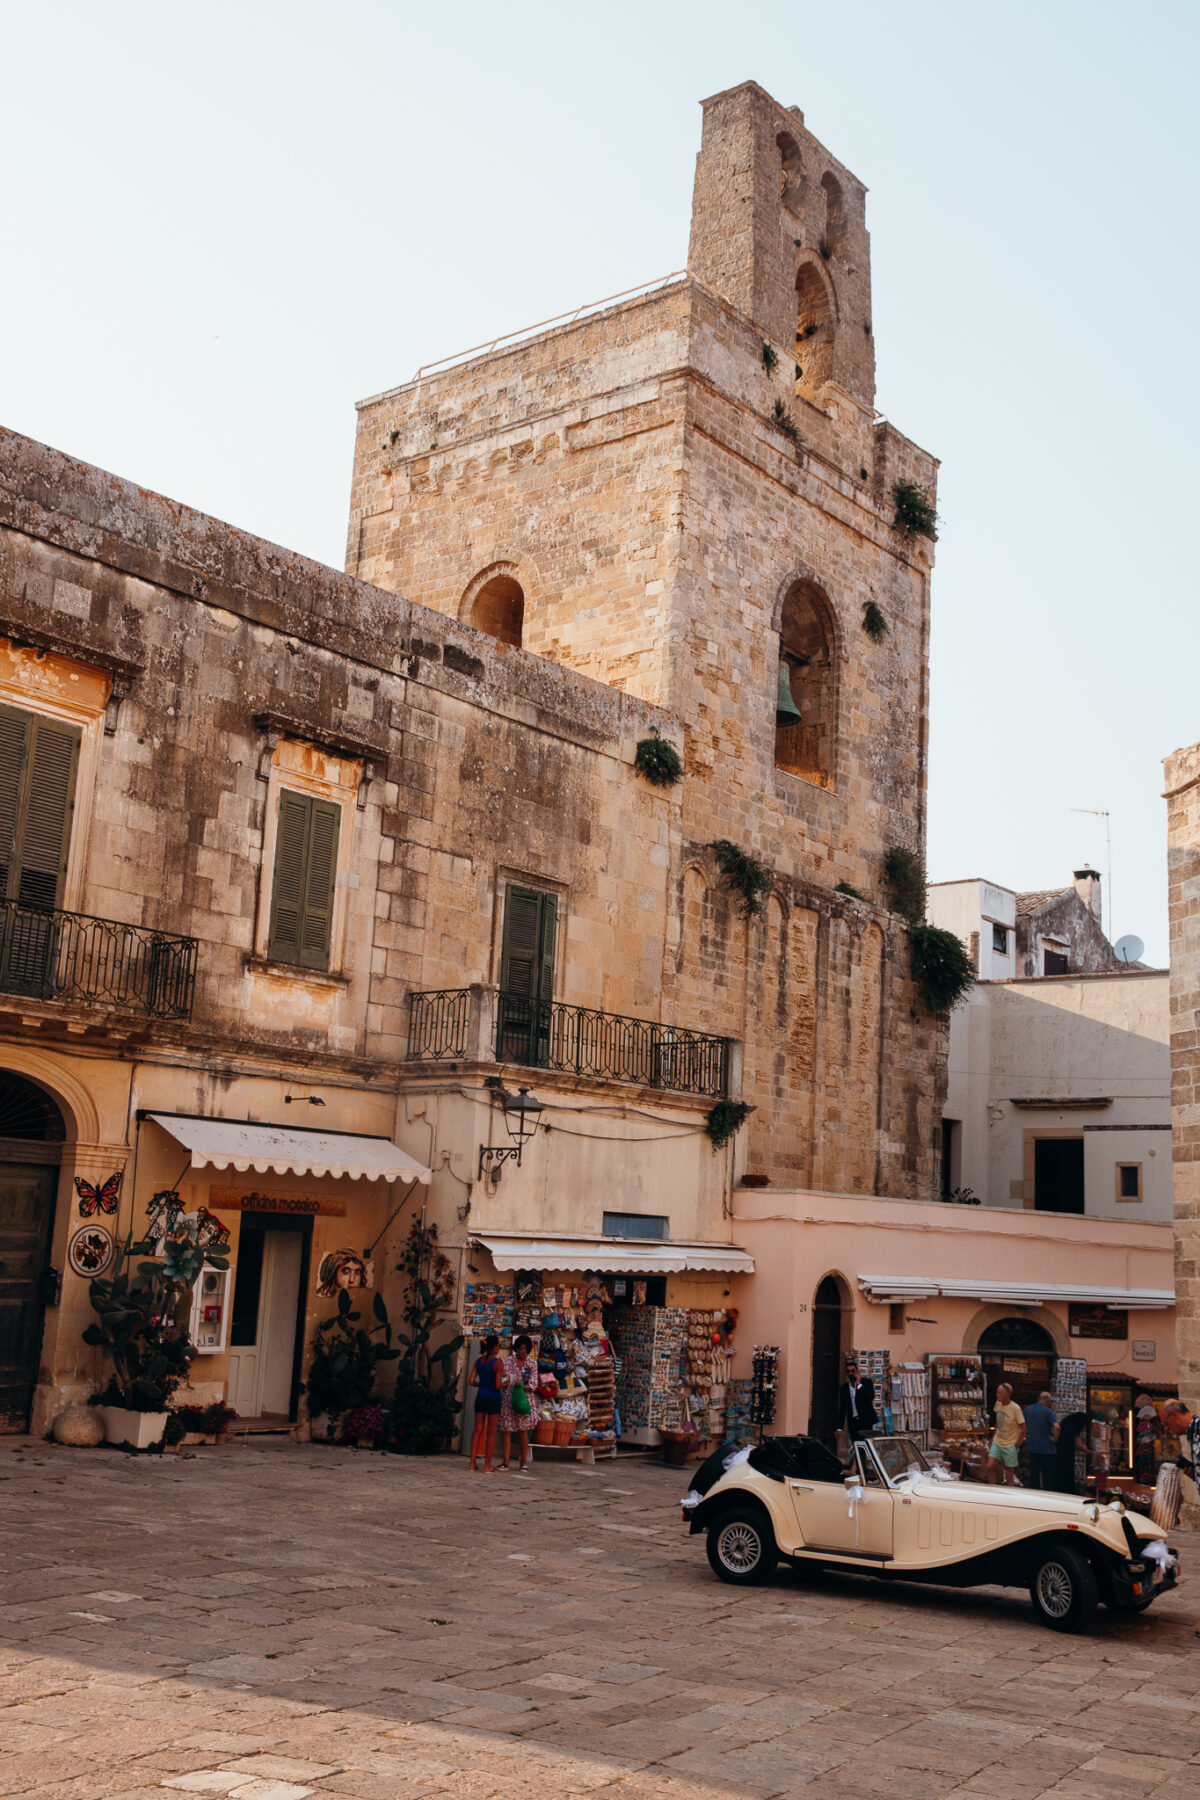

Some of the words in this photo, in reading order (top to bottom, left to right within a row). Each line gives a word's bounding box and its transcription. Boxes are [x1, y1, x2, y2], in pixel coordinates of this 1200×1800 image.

[240, 1192, 277, 1210] officina
[279, 1197, 321, 1212] mosaico
[799, 1303, 807, 1313] 24
